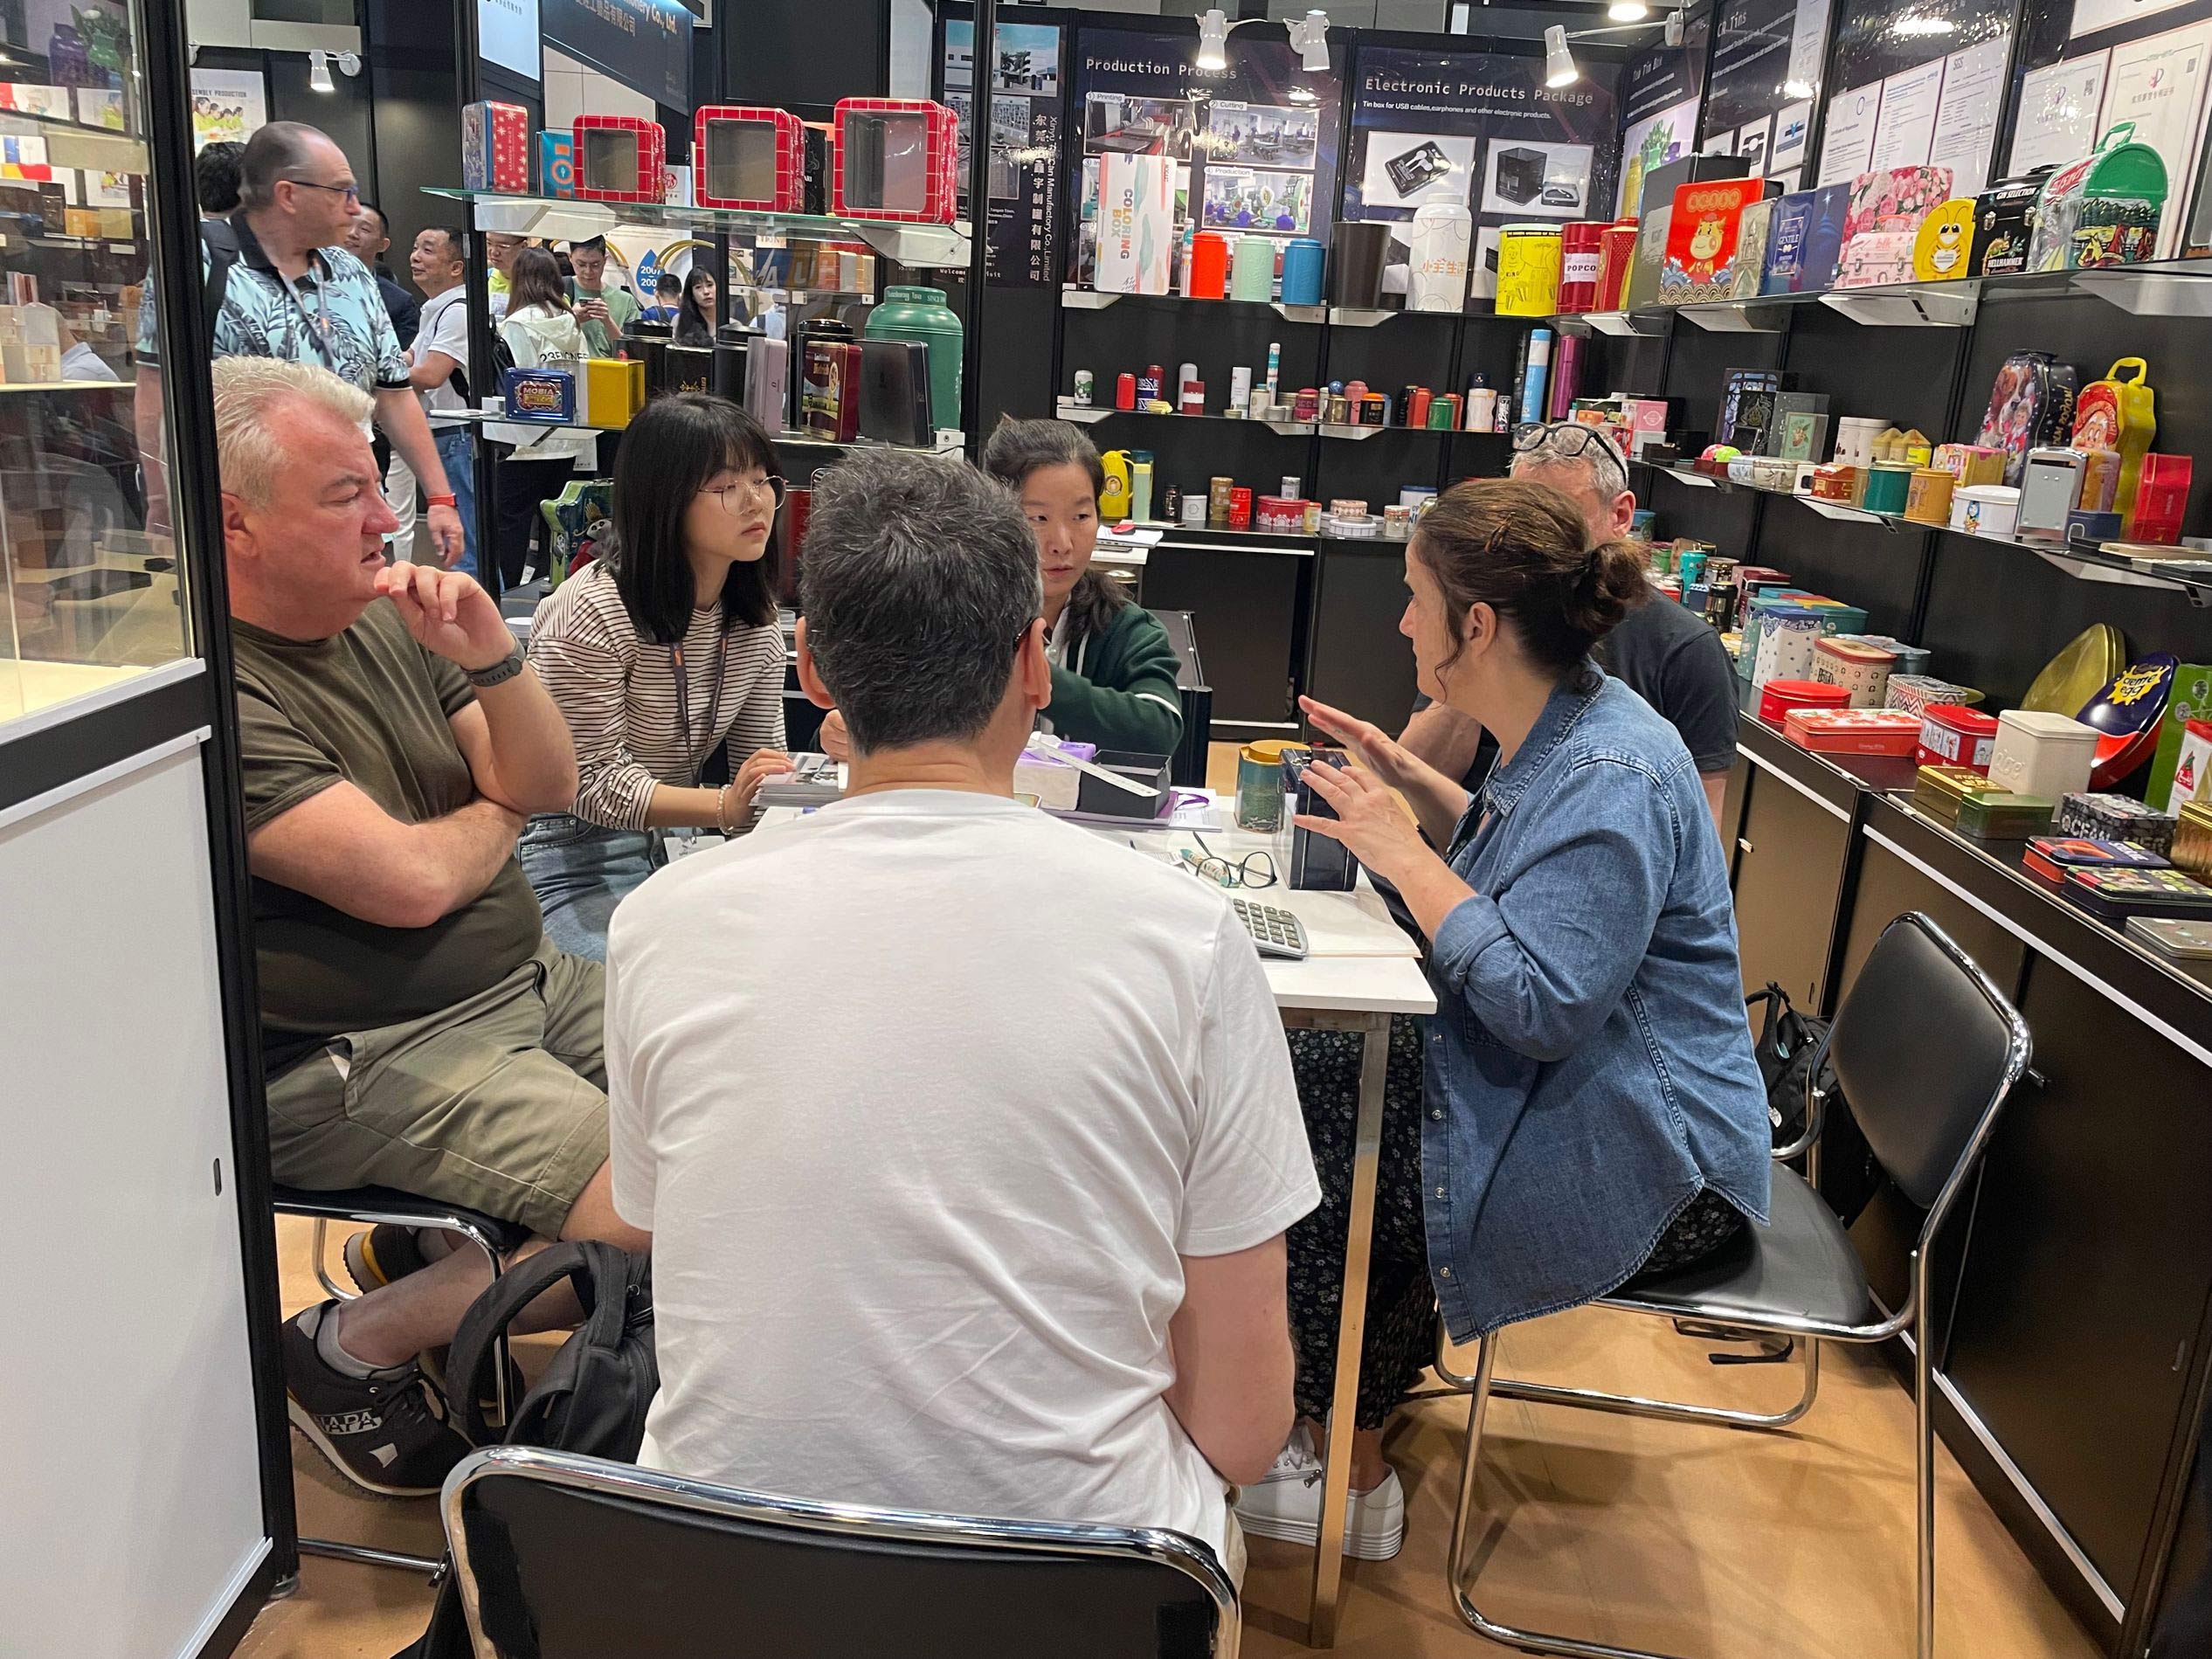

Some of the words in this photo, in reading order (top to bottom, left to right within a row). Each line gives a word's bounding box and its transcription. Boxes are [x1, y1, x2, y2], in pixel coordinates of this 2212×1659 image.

[651, 3, 664, 28] Co.,
[666, 12, 677, 35] Ltd.
[1086, 59, 1170, 76] Production
[1179, 65, 1237, 79] Process
[1096, 93, 1123, 102] Printing
[1365, 78, 1450, 95] Electronic
[1459, 84, 1525, 100] Products
[1534, 89, 1593, 107] Package
[1220, 101, 1244, 110] Cutting
[1395, 102, 1409, 111] USB
[1494, 108, 1523, 118] electronic
[1524, 112, 1552, 121] products.
[1048, 115, 1058, 142] Xinyu
[1215, 168, 1250, 176] Production
[2007, 188, 2036, 198] SELECTION
[1044, 177, 1055, 232] Manufactory
[1110, 209, 1120, 238] BOX
[1120, 189, 1133, 259] COLORING
[641, 278, 657, 287] 200
[2123, 674, 2159, 686] creme
[2120, 685, 2146, 697] egg
